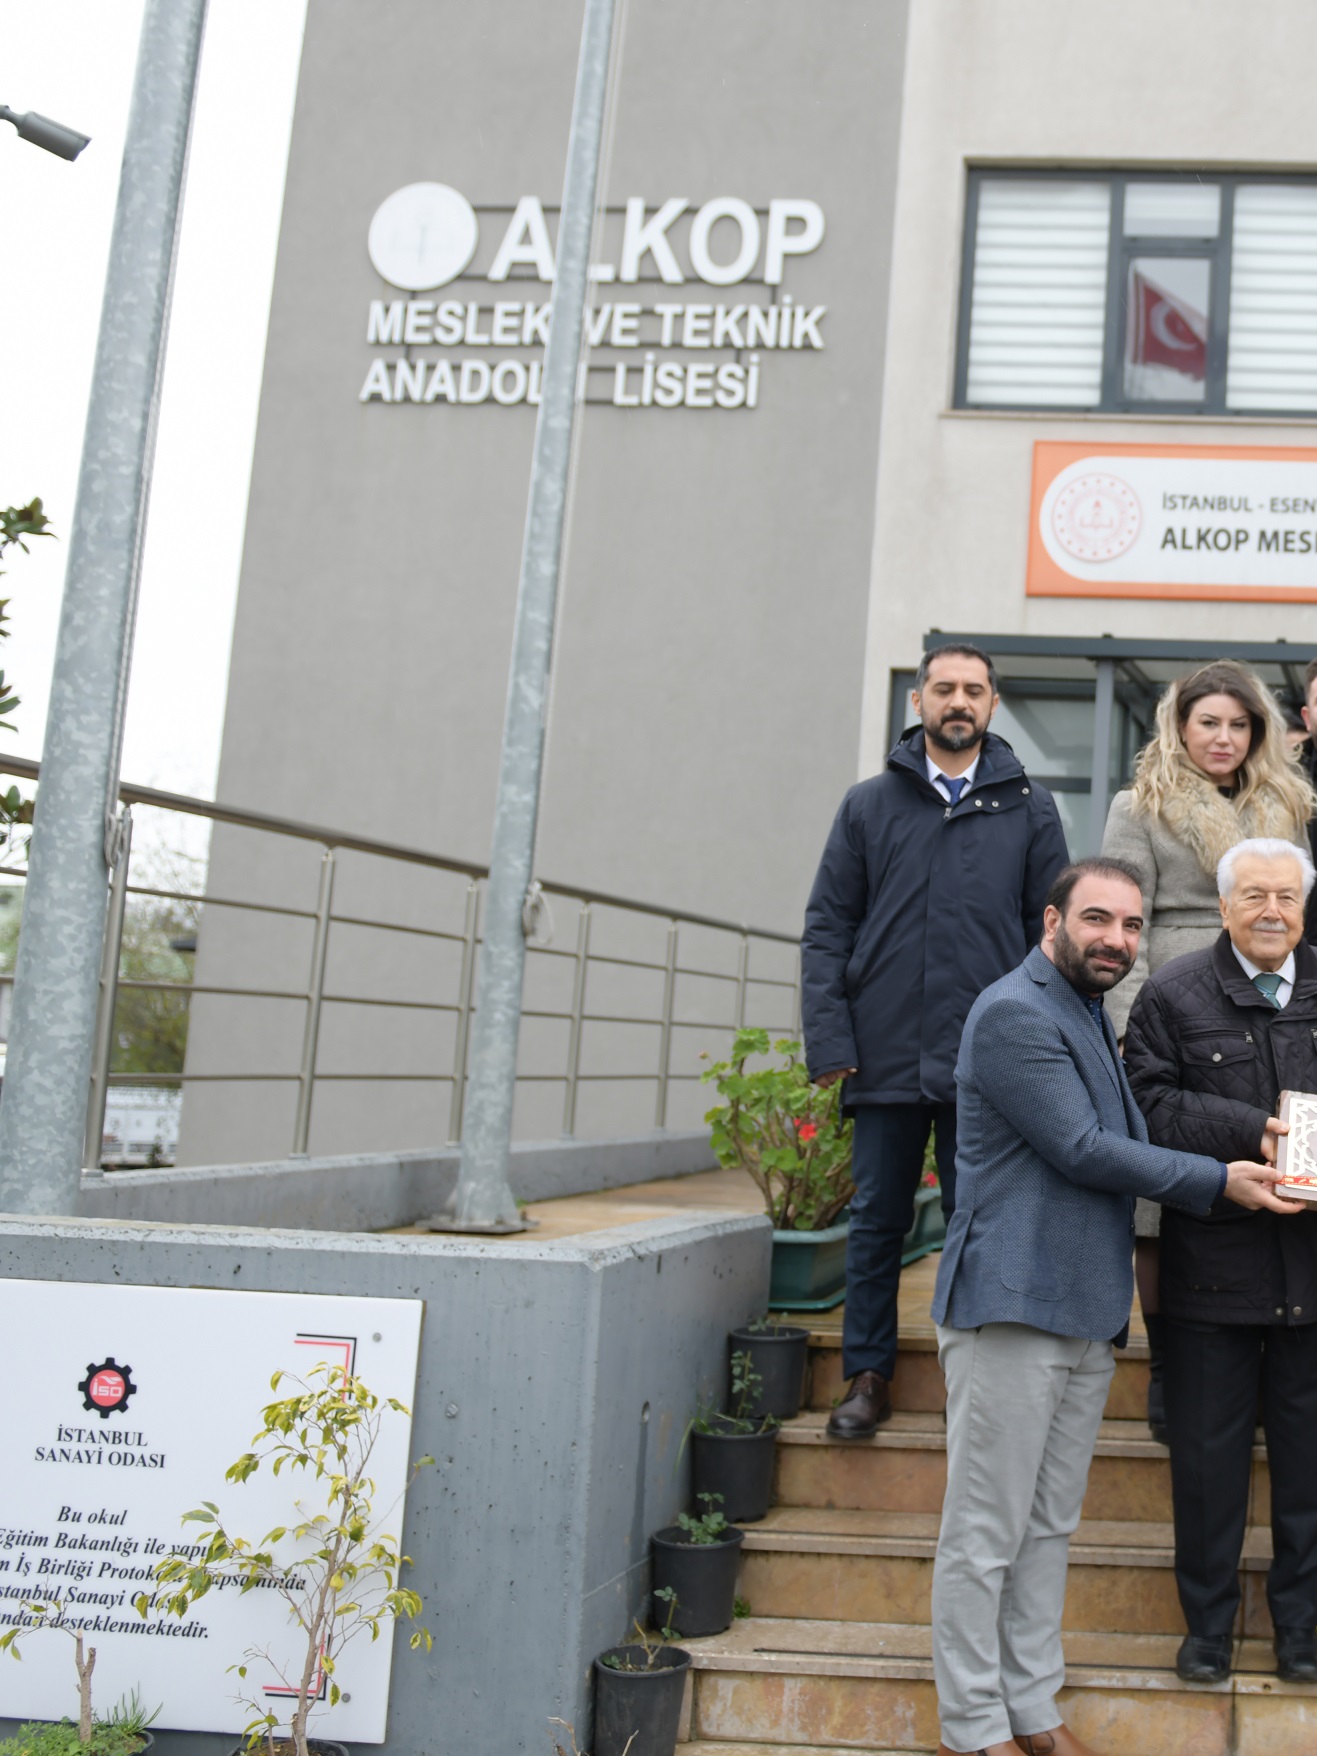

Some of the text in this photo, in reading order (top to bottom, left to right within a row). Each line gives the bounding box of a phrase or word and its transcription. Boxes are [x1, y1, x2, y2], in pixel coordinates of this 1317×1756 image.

[366, 294, 828, 350] MESLEK VE TEKNİK
[359, 351, 760, 408] ANADOL LİSESİ
[1161, 491, 1254, 513] İSTANBUL
[1160, 526, 1250, 552] ALKOP
[56, 1423, 148, 1447] İSTANBUL
[34, 1446, 166, 1469] SANAYİ ODASI
[57, 1505, 128, 1527] Bu okul
[54, 1532, 139, 1558] Bakanlığı
[144, 1537, 166, 1555] ile
[15, 1552, 32, 1577] İş
[36, 1557, 94, 1581] Birliği
[65, 1586, 125, 1610] Sanayi
[49, 1612, 209, 1640] desteklenmektedir.
